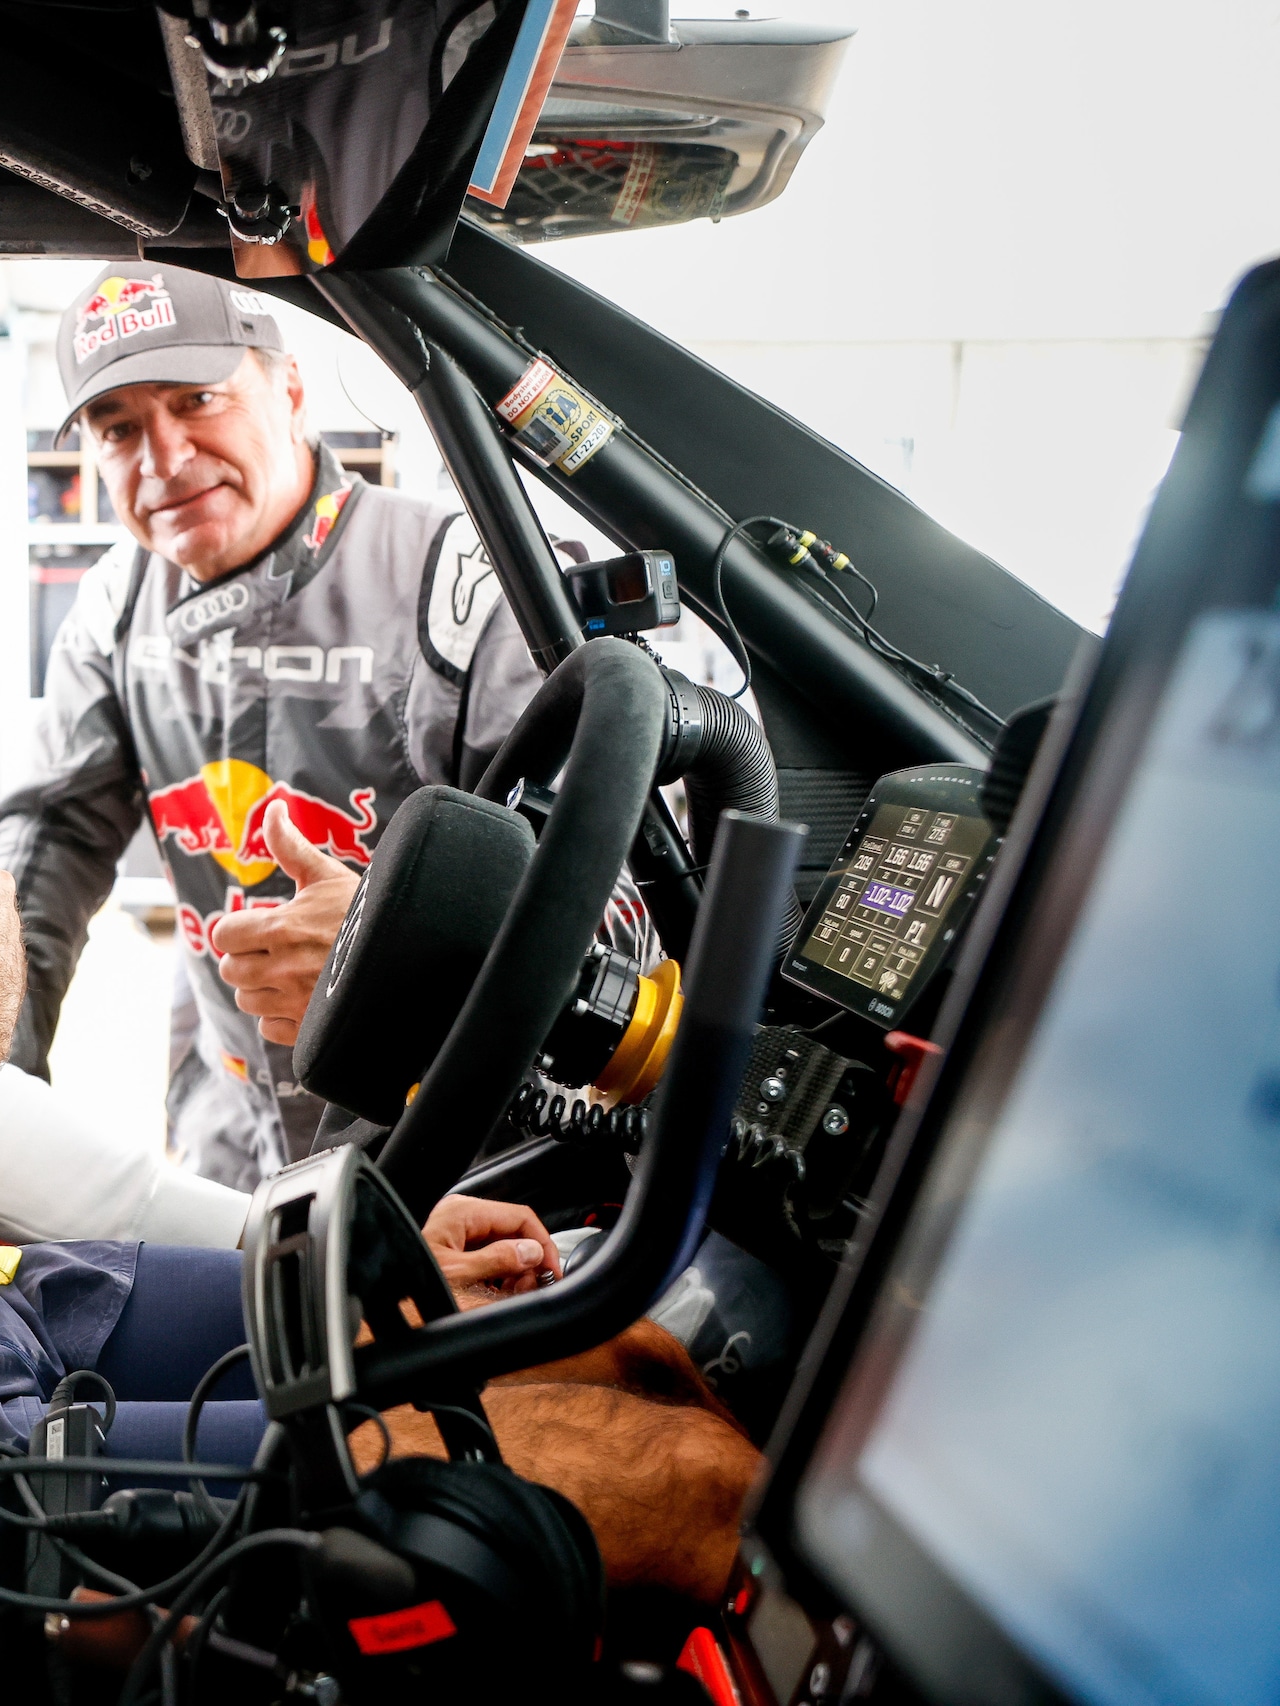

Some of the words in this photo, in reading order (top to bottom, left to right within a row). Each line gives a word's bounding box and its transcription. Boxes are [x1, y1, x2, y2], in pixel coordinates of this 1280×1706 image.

[74, 317, 116, 361] Red
[121, 302, 174, 335] Bull
[507, 406, 519, 418] DO
[518, 391, 533, 408] NOT
[568, 424, 607, 465] TT-22-203
[854, 855, 874, 871] 209
[835, 893, 851, 910] 80
[925, 875, 953, 908] N
[903, 920, 927, 944] P1
[839, 947, 851, 962] 0
